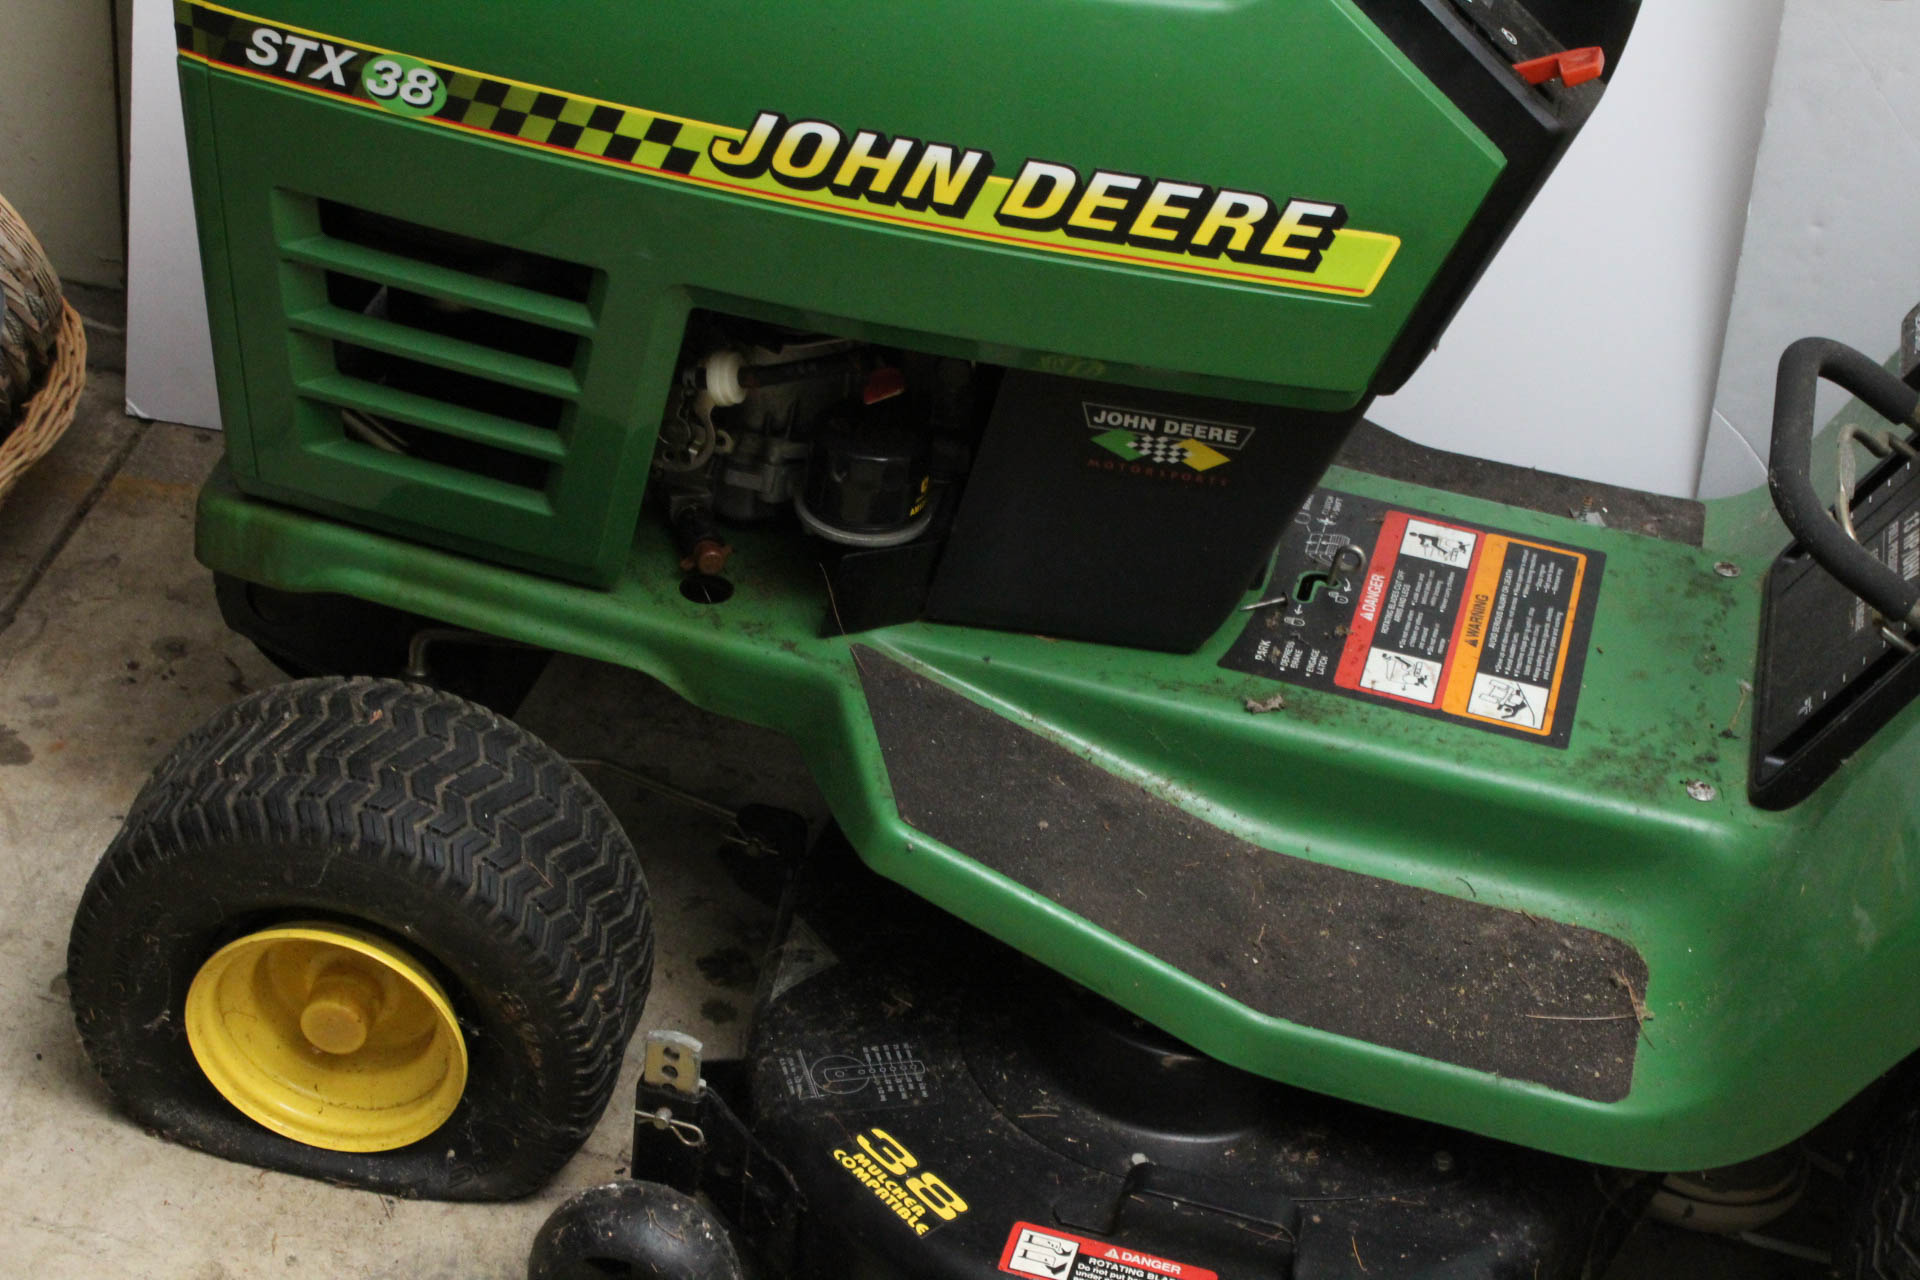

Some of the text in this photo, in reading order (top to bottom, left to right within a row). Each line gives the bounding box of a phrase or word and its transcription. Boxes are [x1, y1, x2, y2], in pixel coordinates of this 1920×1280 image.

[246, 27, 438, 107] STX 38
[709, 111, 1341, 266] JOHN DEERE
[1093, 410, 1240, 444] JOHN DEERE
[1904, 511, 1919, 533] 13
[1503, 568, 1513, 585] DEATH
[1362, 574, 1386, 612] DANGER
[1501, 584, 1509, 593] OR
[1380, 608, 1394, 634] ROTATING
[1387, 589, 1400, 610] BLADES
[1396, 569, 1406, 580] OFF
[1397, 596, 1406, 608] AND
[1466, 594, 1489, 638] WARNING
[1491, 610, 1503, 633] SERIOUS
[1255, 640, 1271, 661] PARK
[1487, 632, 1498, 648] AVOID
[1281, 641, 1296, 667] DEPRESS
[1306, 649, 1320, 673] ENGAGE
[1316, 655, 1328, 675] LATCH
[853, 1153, 926, 1212] MULCHER
[857, 1128, 968, 1220] 38
[833, 1149, 929, 1236] COMPATIBLE
[1077, 1262, 1091, 1271] Do
[1092, 1267, 1109, 1277] not
[1109, 1271, 1126, 1280] put
[1089, 1257, 1145, 1278] ROTATING
[1121, 1252, 1182, 1275] DANGER
